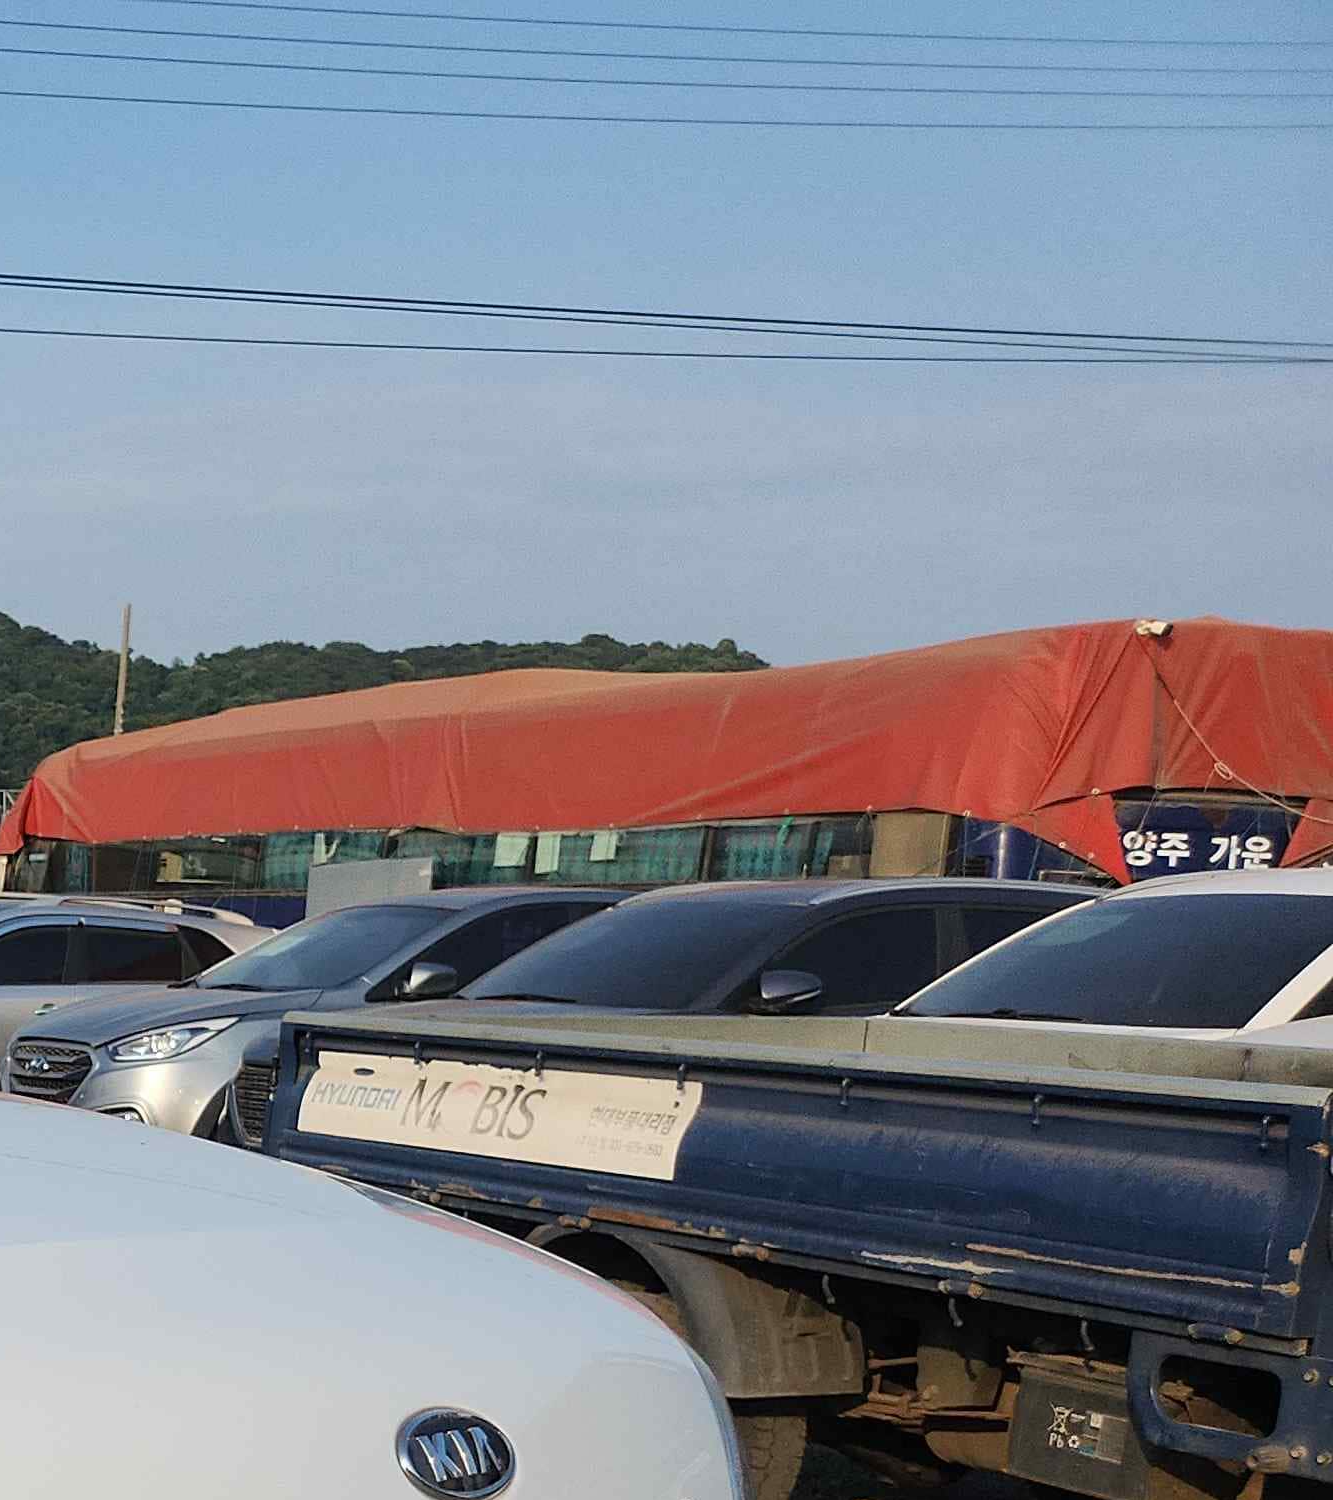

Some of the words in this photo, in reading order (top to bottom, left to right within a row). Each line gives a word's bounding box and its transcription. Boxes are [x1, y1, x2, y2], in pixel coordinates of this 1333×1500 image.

[1122, 830, 1191, 868] 양주
[1208, 834, 1274, 870] 가운
[311, 1081, 402, 1111] HYUNDAI
[399, 1075, 547, 1140] MBIS
[414, 1426, 503, 1483] KIA
[1048, 1432, 1065, 1449] Pb
